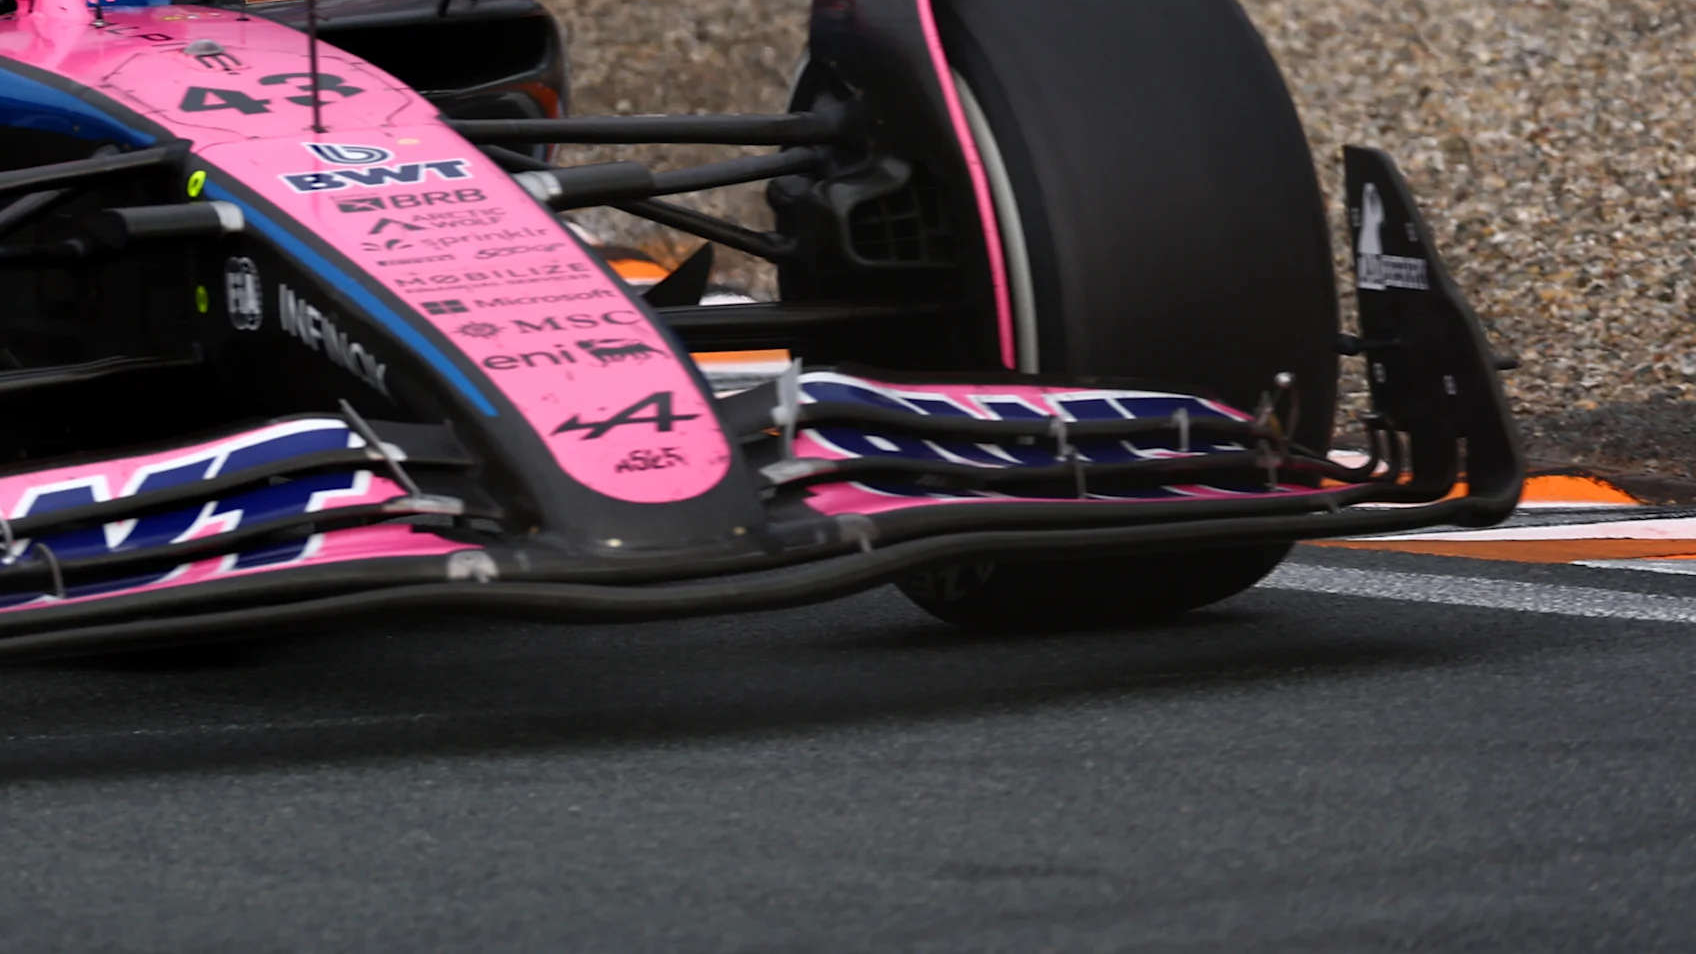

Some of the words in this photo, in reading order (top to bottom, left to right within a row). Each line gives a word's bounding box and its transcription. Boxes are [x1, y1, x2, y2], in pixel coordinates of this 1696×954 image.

[180, 72, 365, 115] 43
[278, 160, 474, 193] BWT
[389, 187, 488, 210] BRB
[473, 288, 618, 309] Microsoft
[510, 310, 644, 335] MSC
[483, 344, 579, 370] eni
